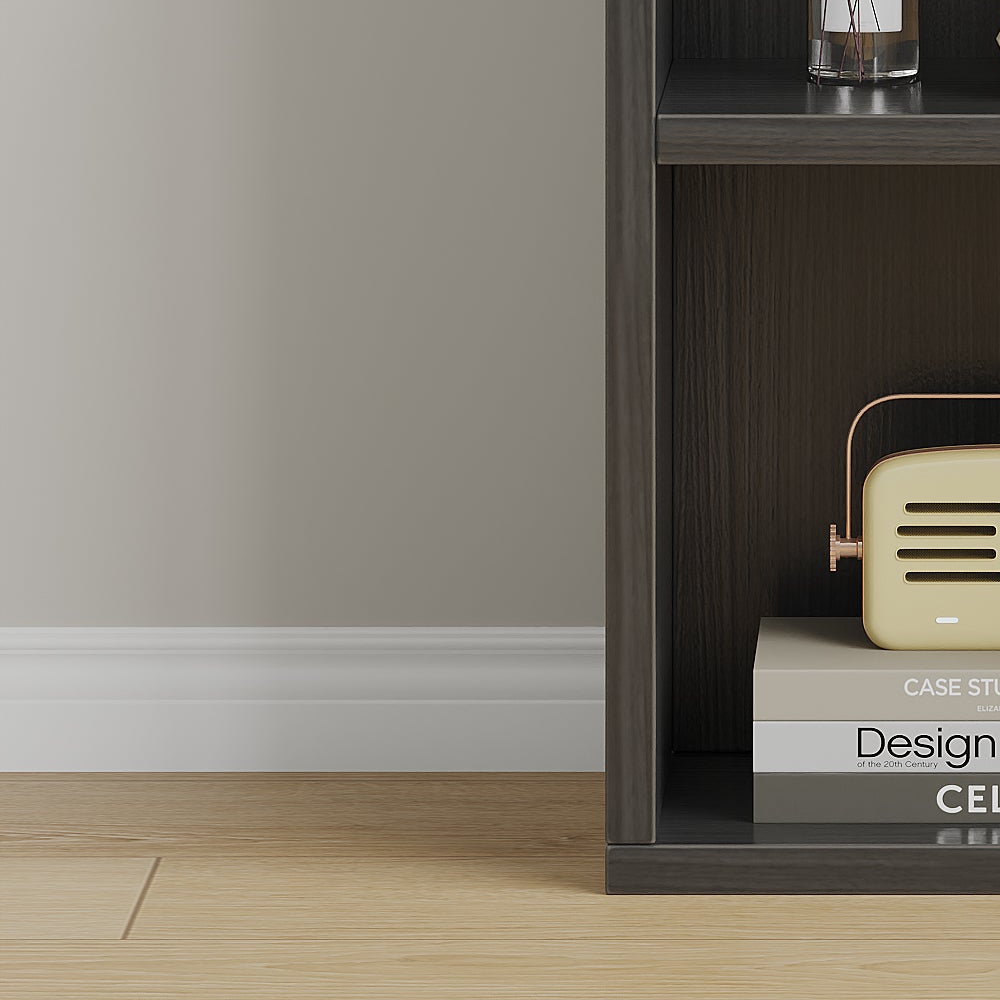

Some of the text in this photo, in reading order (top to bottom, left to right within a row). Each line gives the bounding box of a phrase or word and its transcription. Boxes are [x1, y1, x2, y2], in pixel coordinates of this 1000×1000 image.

[903, 678, 962, 697] CASE
[856, 727, 997, 769] Design
[856, 760, 939, 770] of the 20th Century
